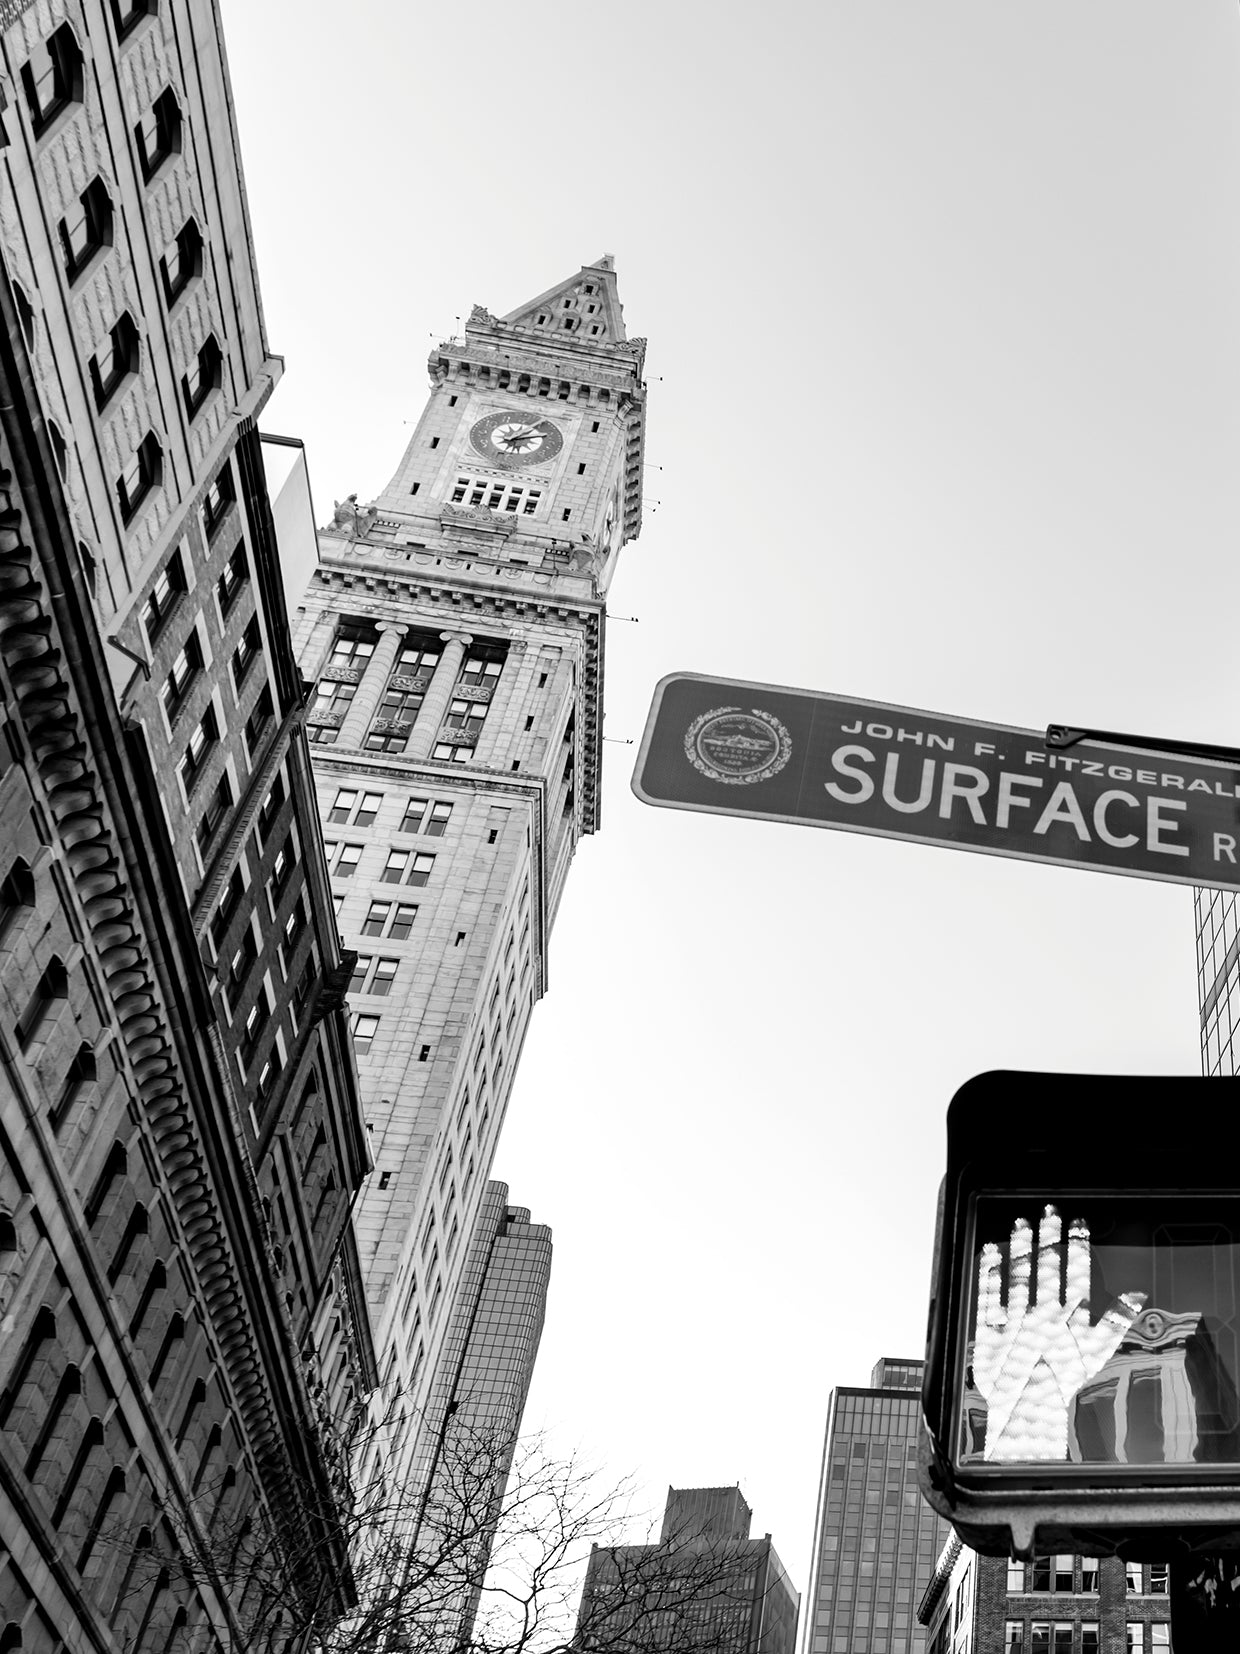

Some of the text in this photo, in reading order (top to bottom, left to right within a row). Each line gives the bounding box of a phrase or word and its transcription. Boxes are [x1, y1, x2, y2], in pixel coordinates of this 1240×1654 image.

[841, 720, 955, 751] JOHN
[974, 742, 1005, 760] F.
[824, 744, 1190, 857] SURFACE
